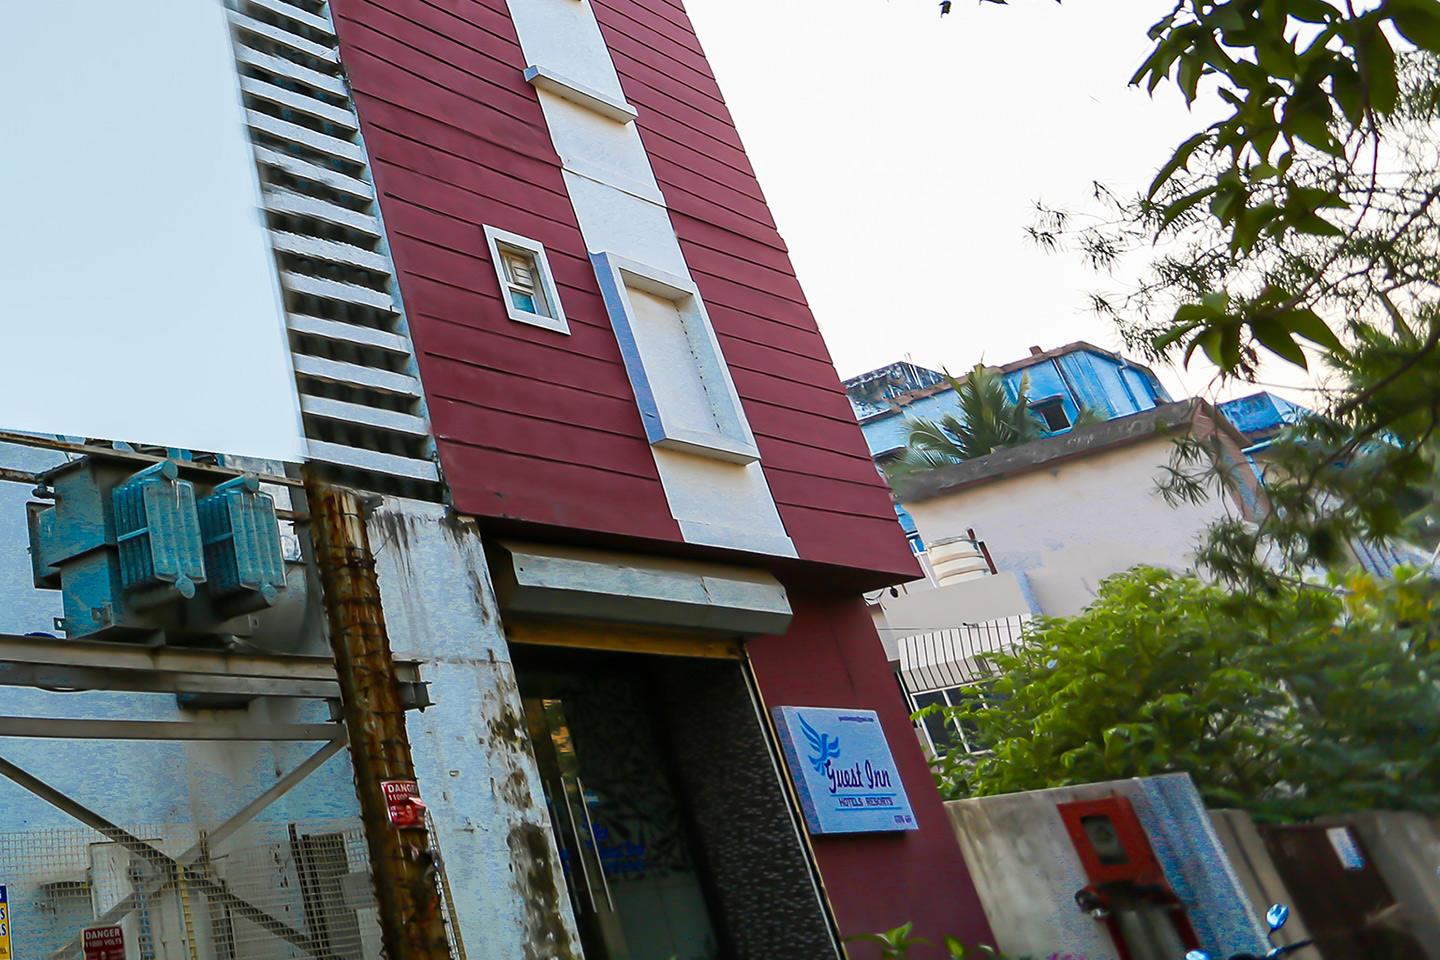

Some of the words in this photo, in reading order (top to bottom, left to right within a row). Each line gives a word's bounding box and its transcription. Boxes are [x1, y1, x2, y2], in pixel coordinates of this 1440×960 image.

[824, 758, 864, 793] Guest
[865, 759, 892, 789] Inn
[85, 928, 121, 940] DANGER
